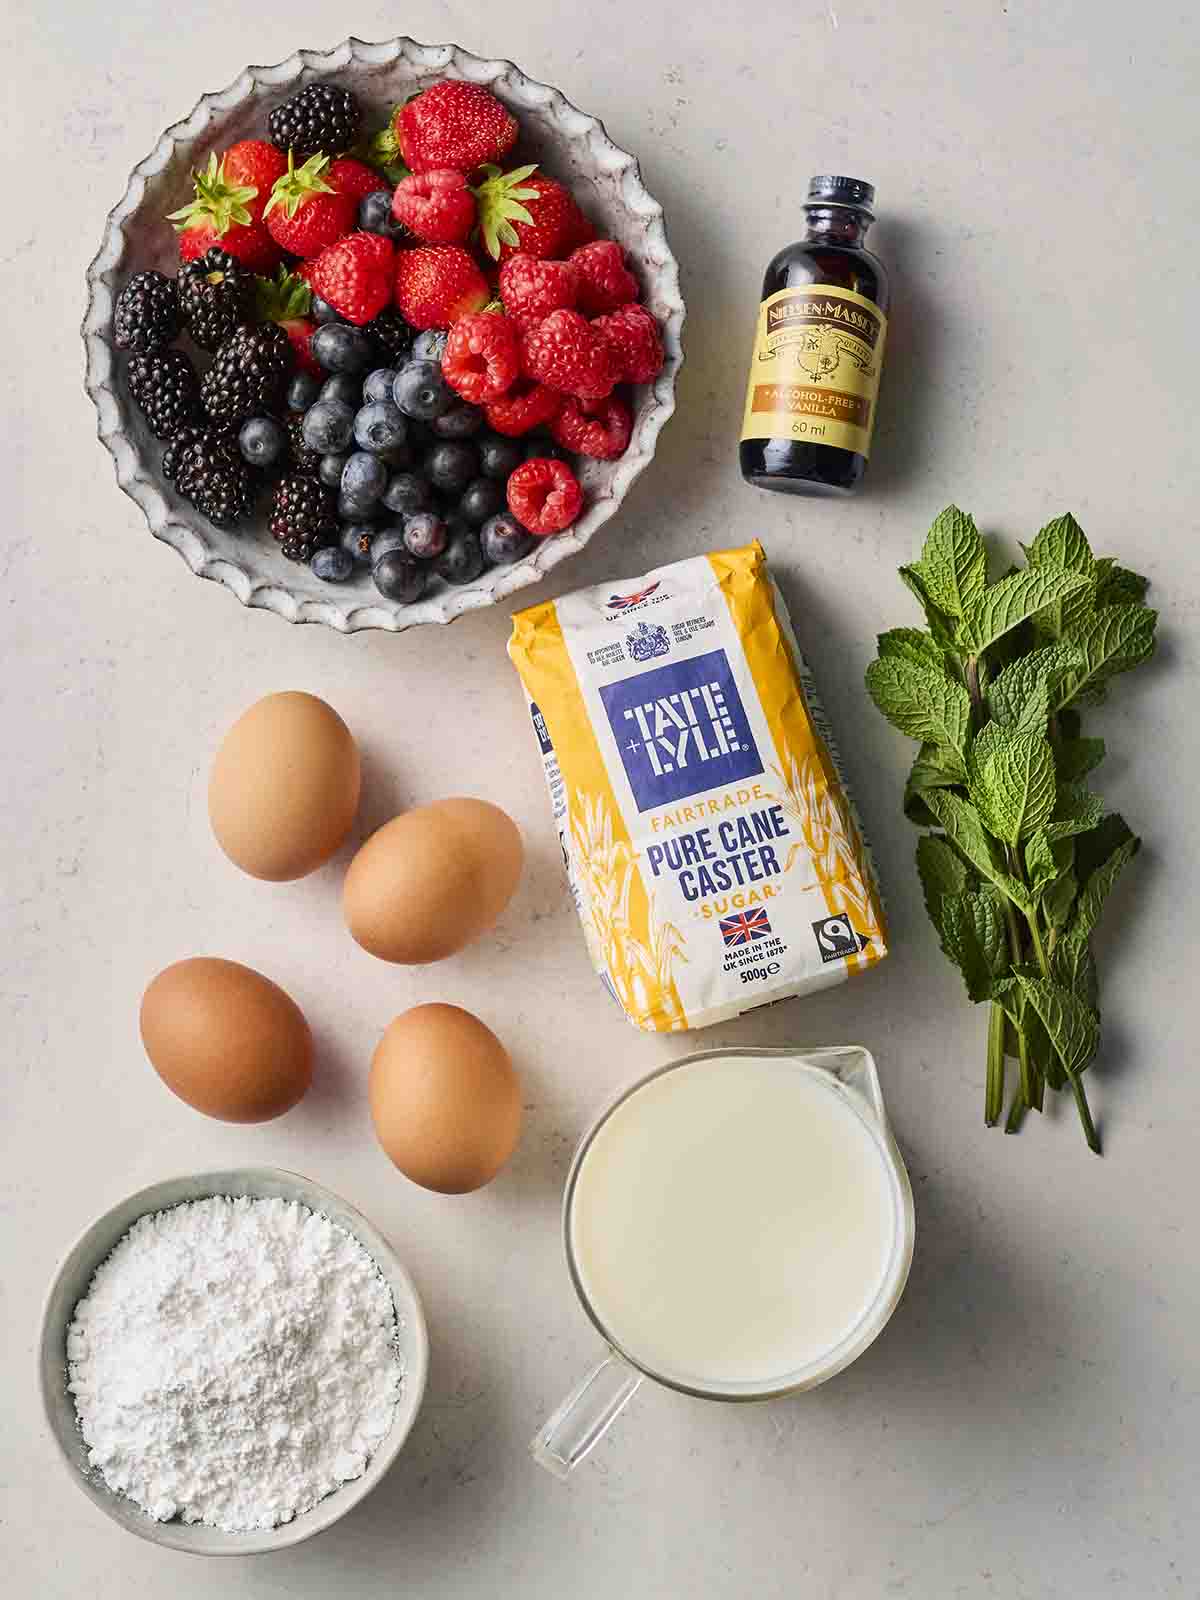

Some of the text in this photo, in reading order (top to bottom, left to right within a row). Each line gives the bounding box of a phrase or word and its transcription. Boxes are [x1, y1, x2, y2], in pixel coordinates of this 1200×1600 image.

[773, 389, 855, 409] ALCOHOL-FREE
[787, 400, 837, 416] VANILLA
[791, 422, 825, 436] 60 ml
[606, 613, 620, 621] UK
[624, 681, 728, 740] TATE
[651, 784, 764, 832] FAIRTRADE
[646, 804, 790, 877] PURE CANE
[678, 845, 781, 902] CASTER
[701, 884, 776, 918] SUGAR
[724, 937, 782, 961] MADE IN THE
[723, 961, 737, 972] UK
[739, 954, 765, 967] SINCE
